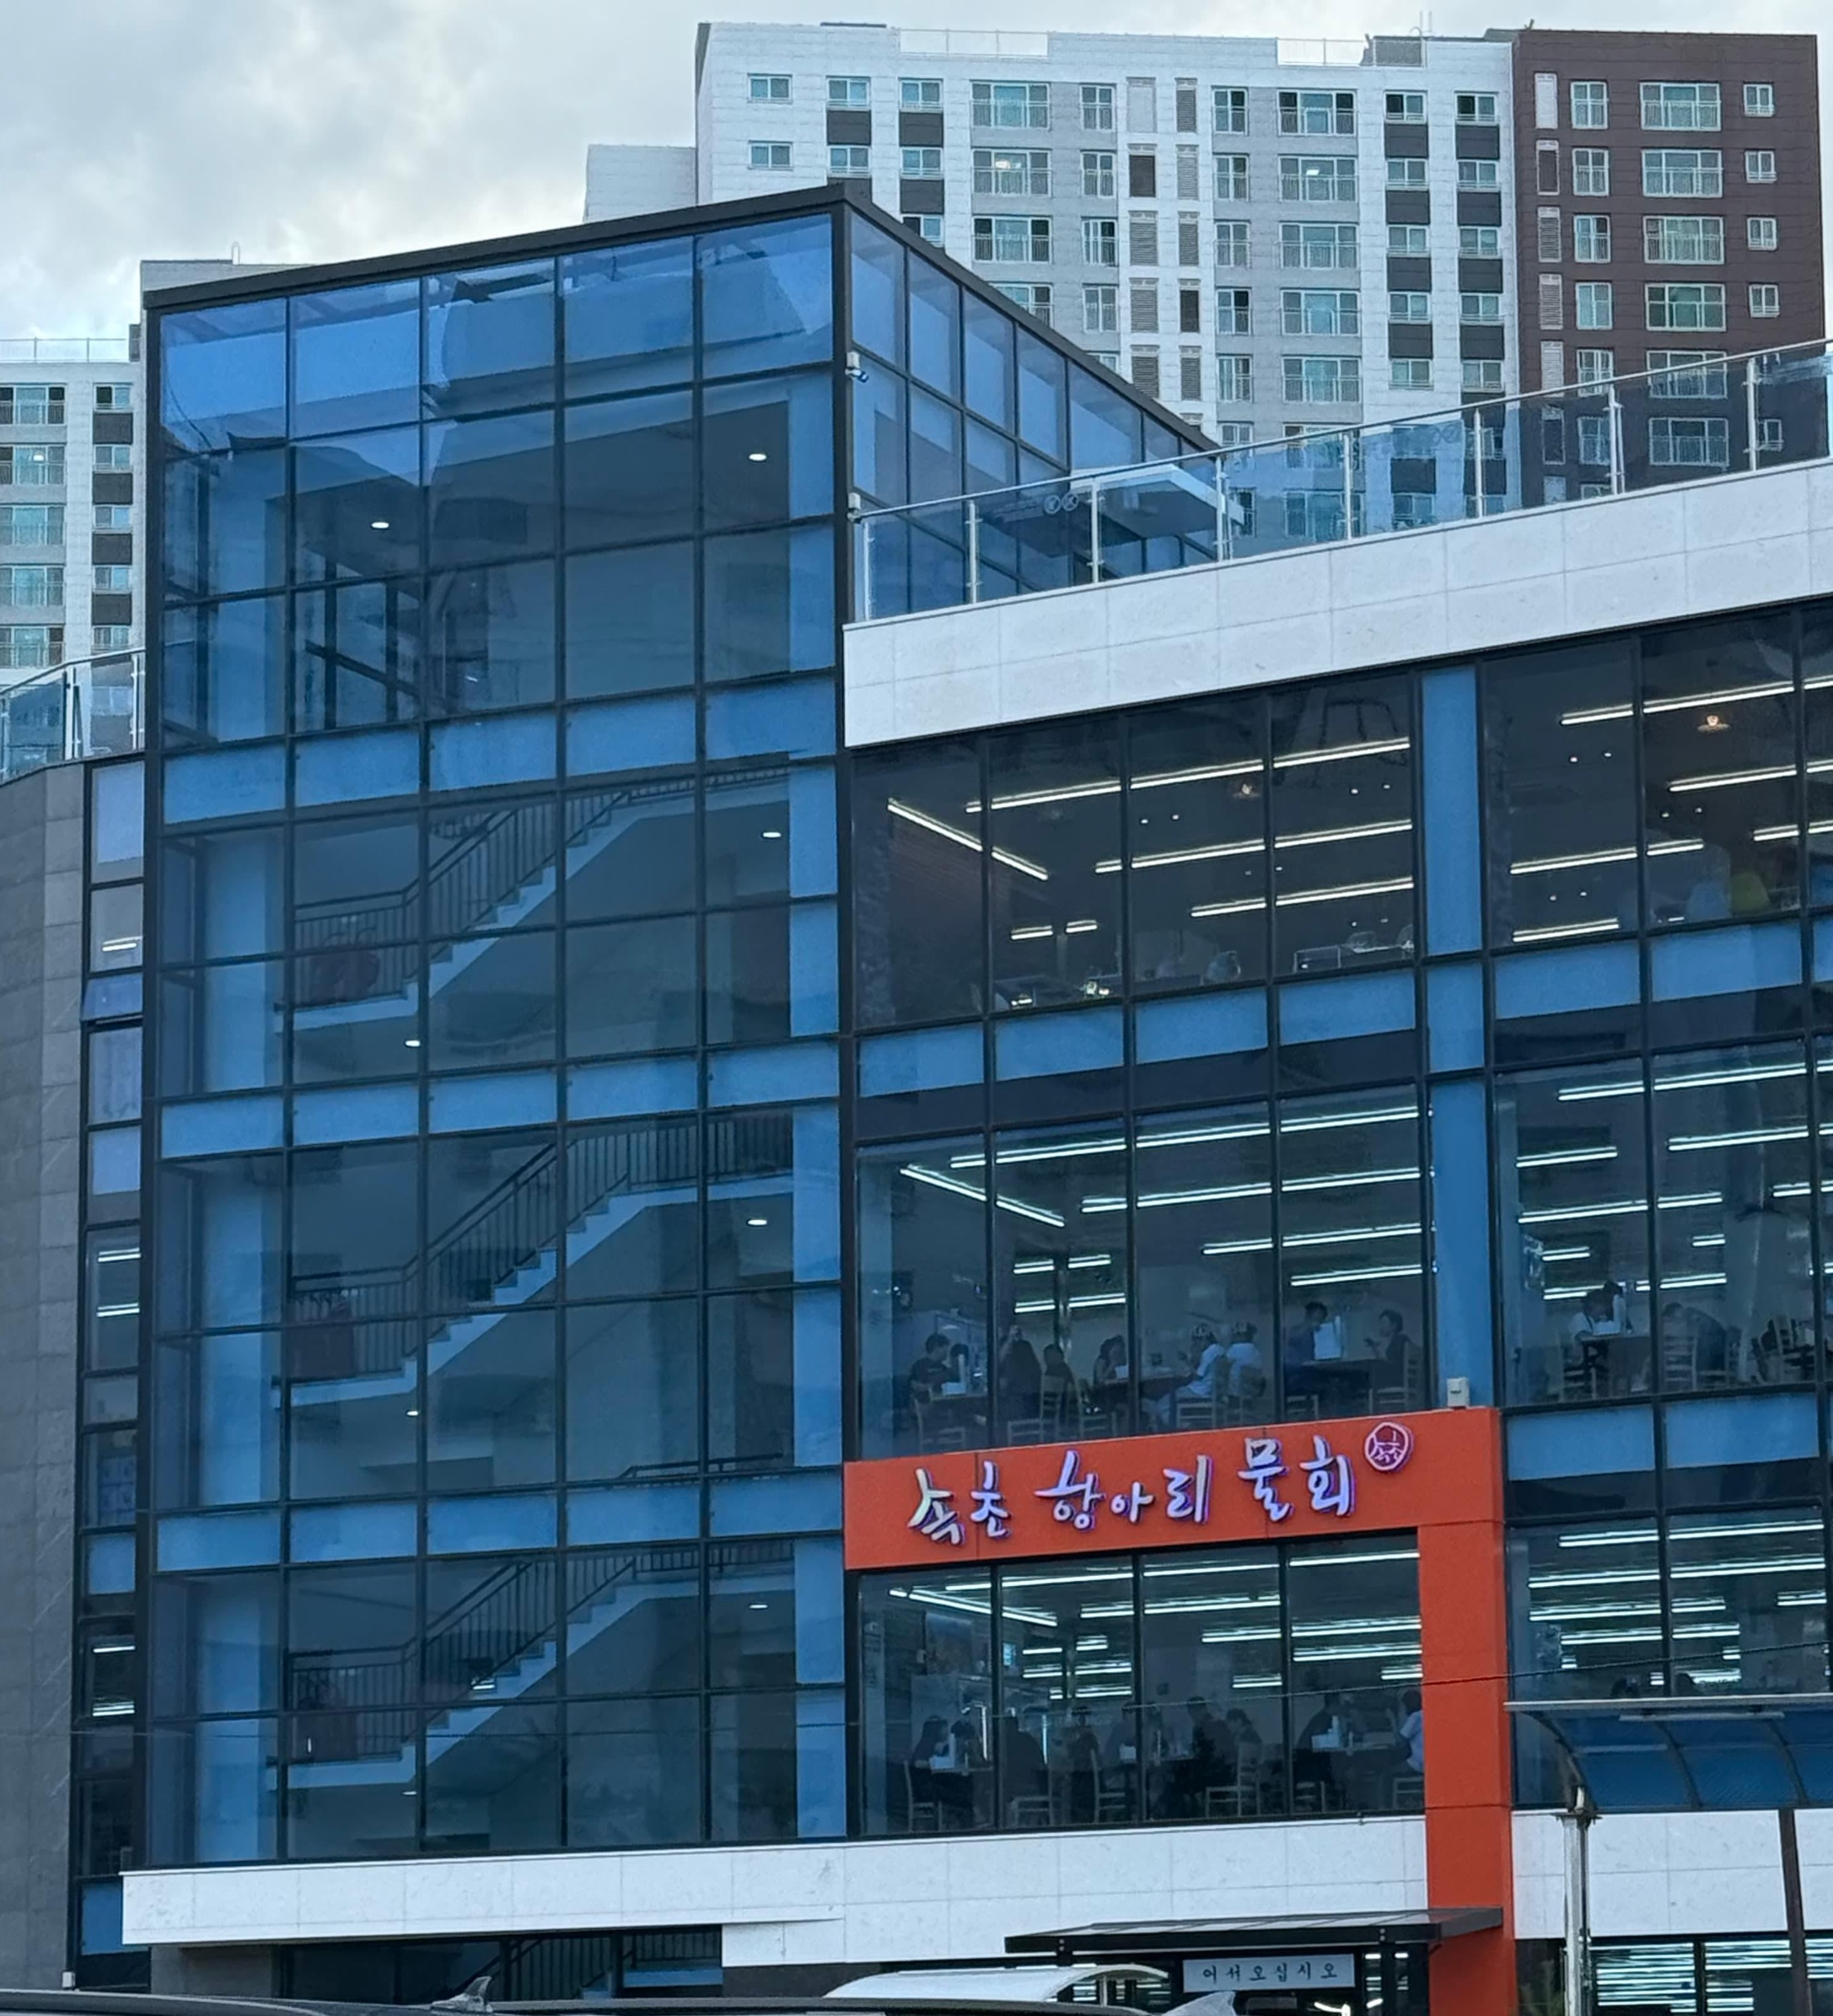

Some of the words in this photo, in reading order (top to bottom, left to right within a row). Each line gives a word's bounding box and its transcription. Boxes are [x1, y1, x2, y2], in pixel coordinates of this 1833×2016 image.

[908, 1460, 1012, 1546] 속초
[1034, 1450, 1211, 1531] 항아리
[1238, 1434, 1354, 1522] 물회
[1202, 1962, 1337, 1982] 어서오십시오
